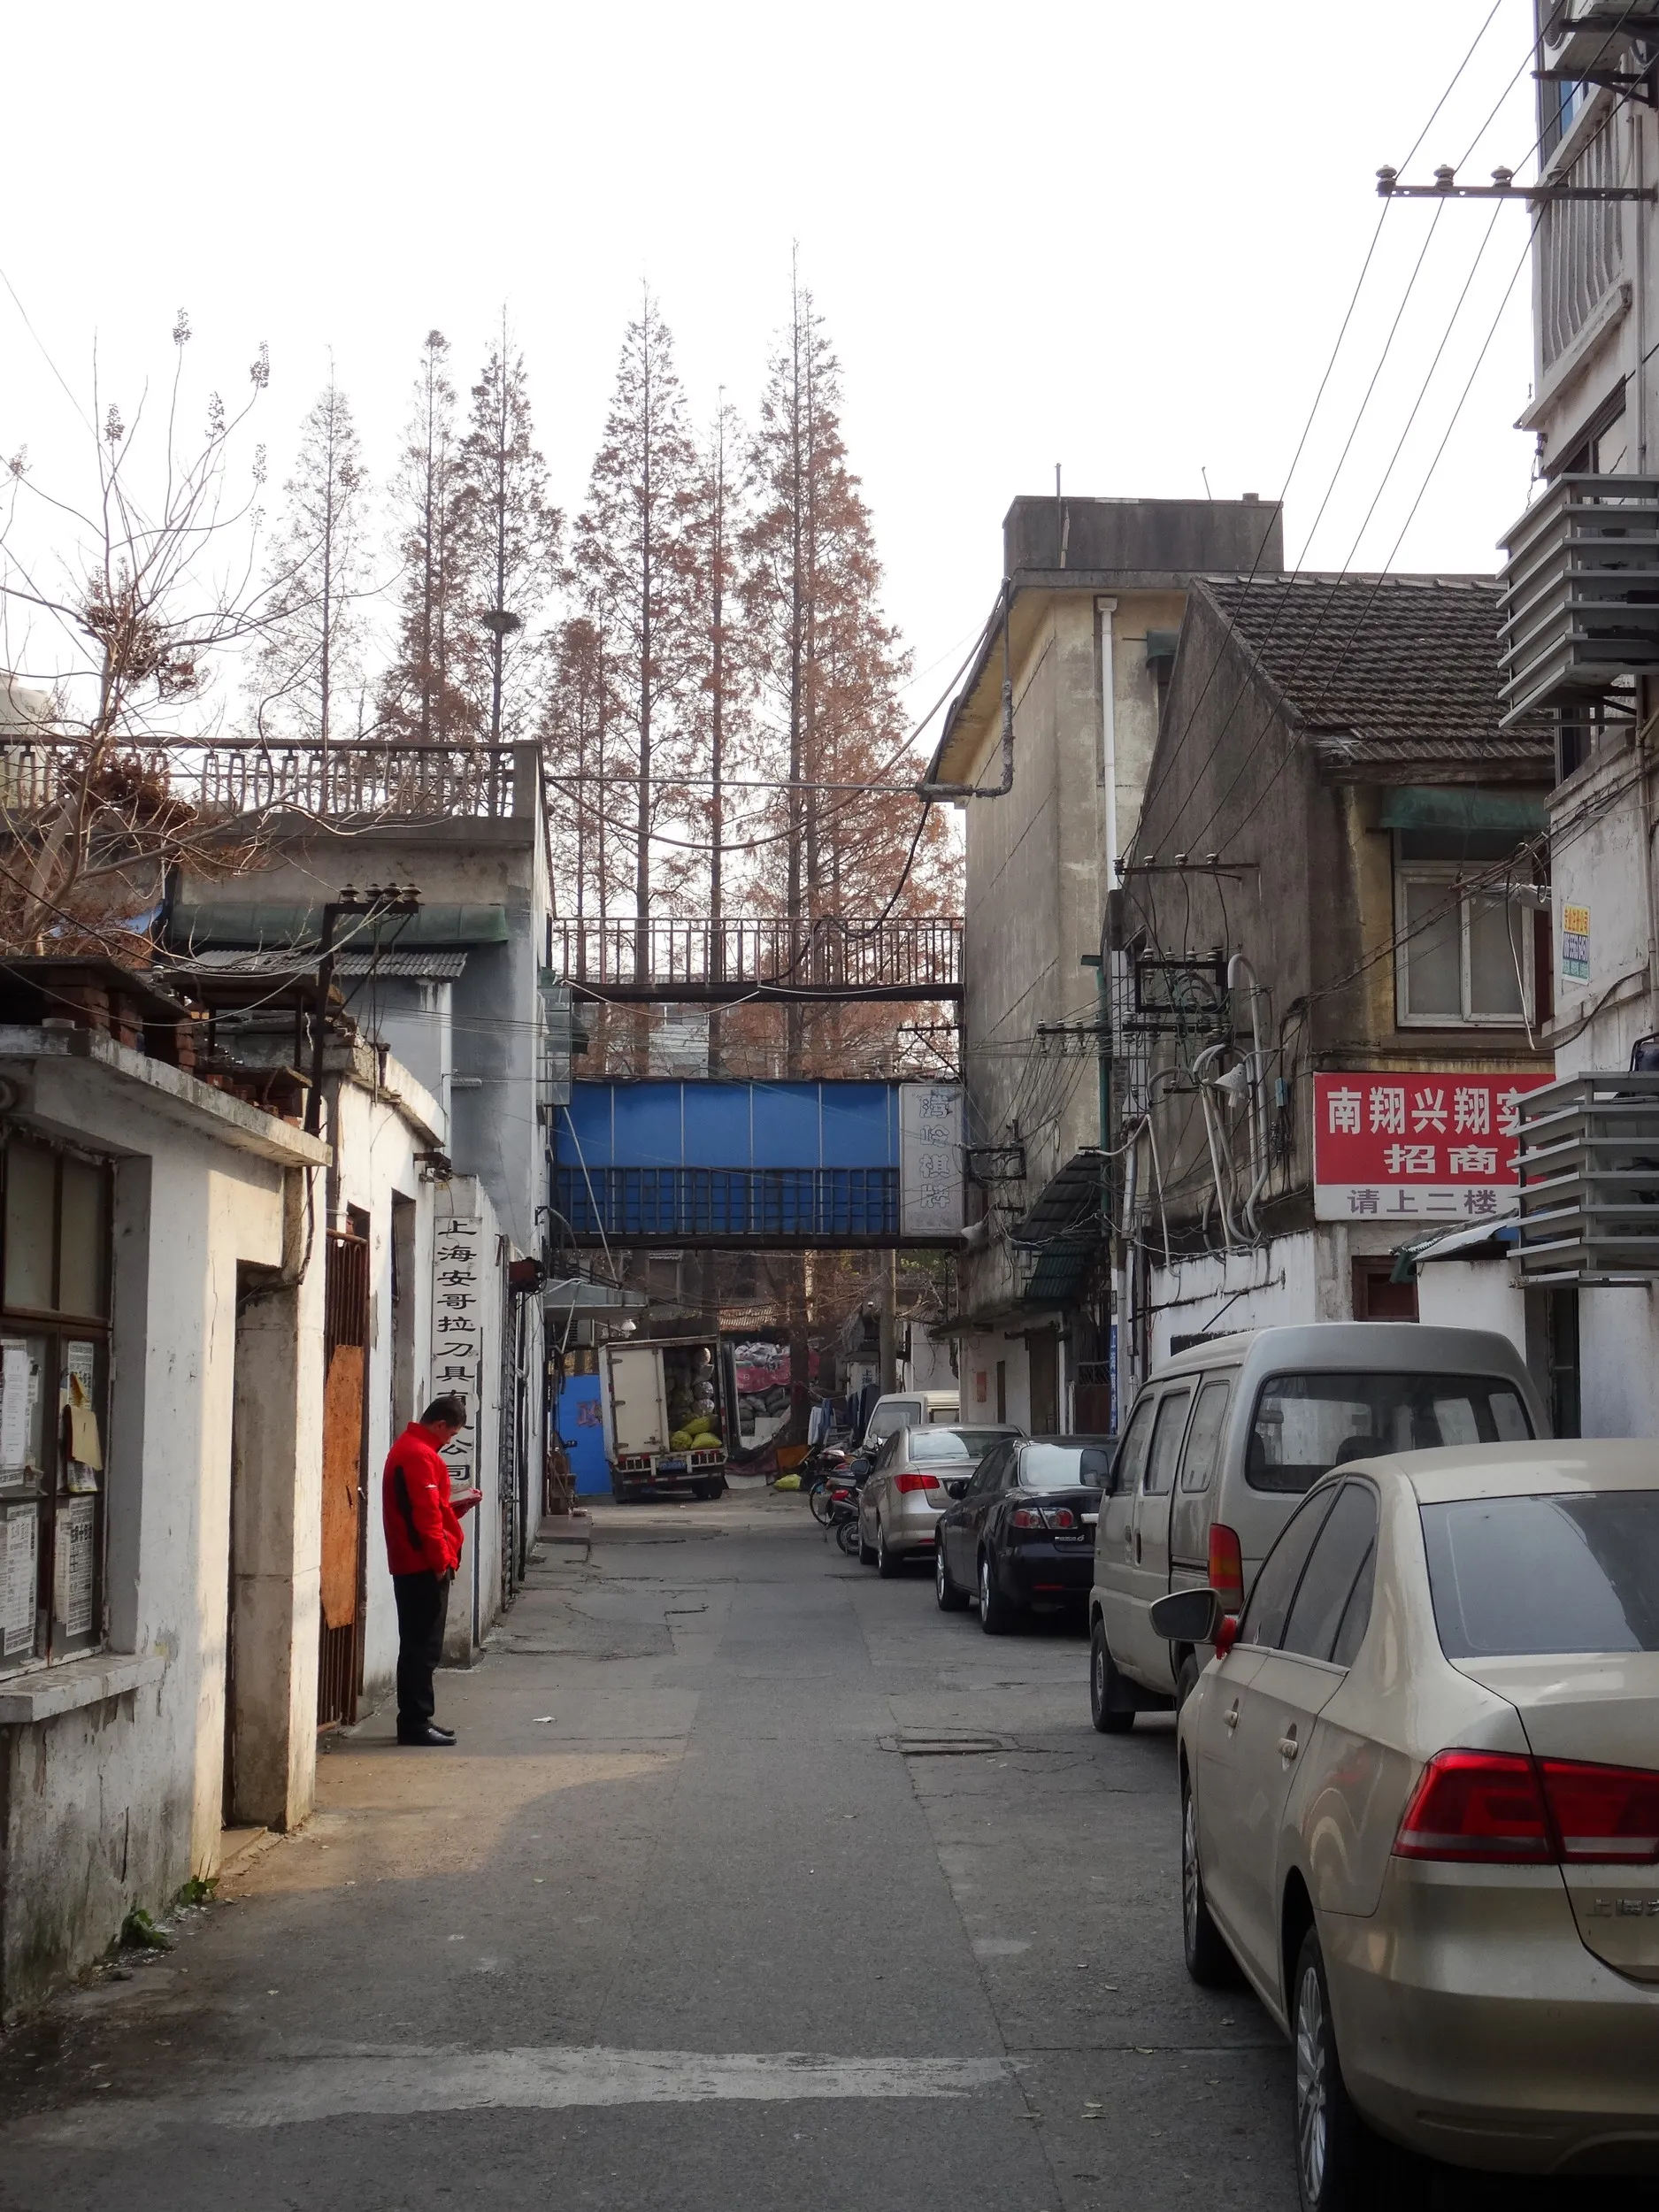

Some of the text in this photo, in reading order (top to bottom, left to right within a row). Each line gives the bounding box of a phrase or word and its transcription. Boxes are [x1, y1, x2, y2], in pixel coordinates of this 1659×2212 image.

[1347, 1188, 1497, 1216] 请上二楼
[435, 1219, 478, 1481] 上海安哥拉刀具有公司
